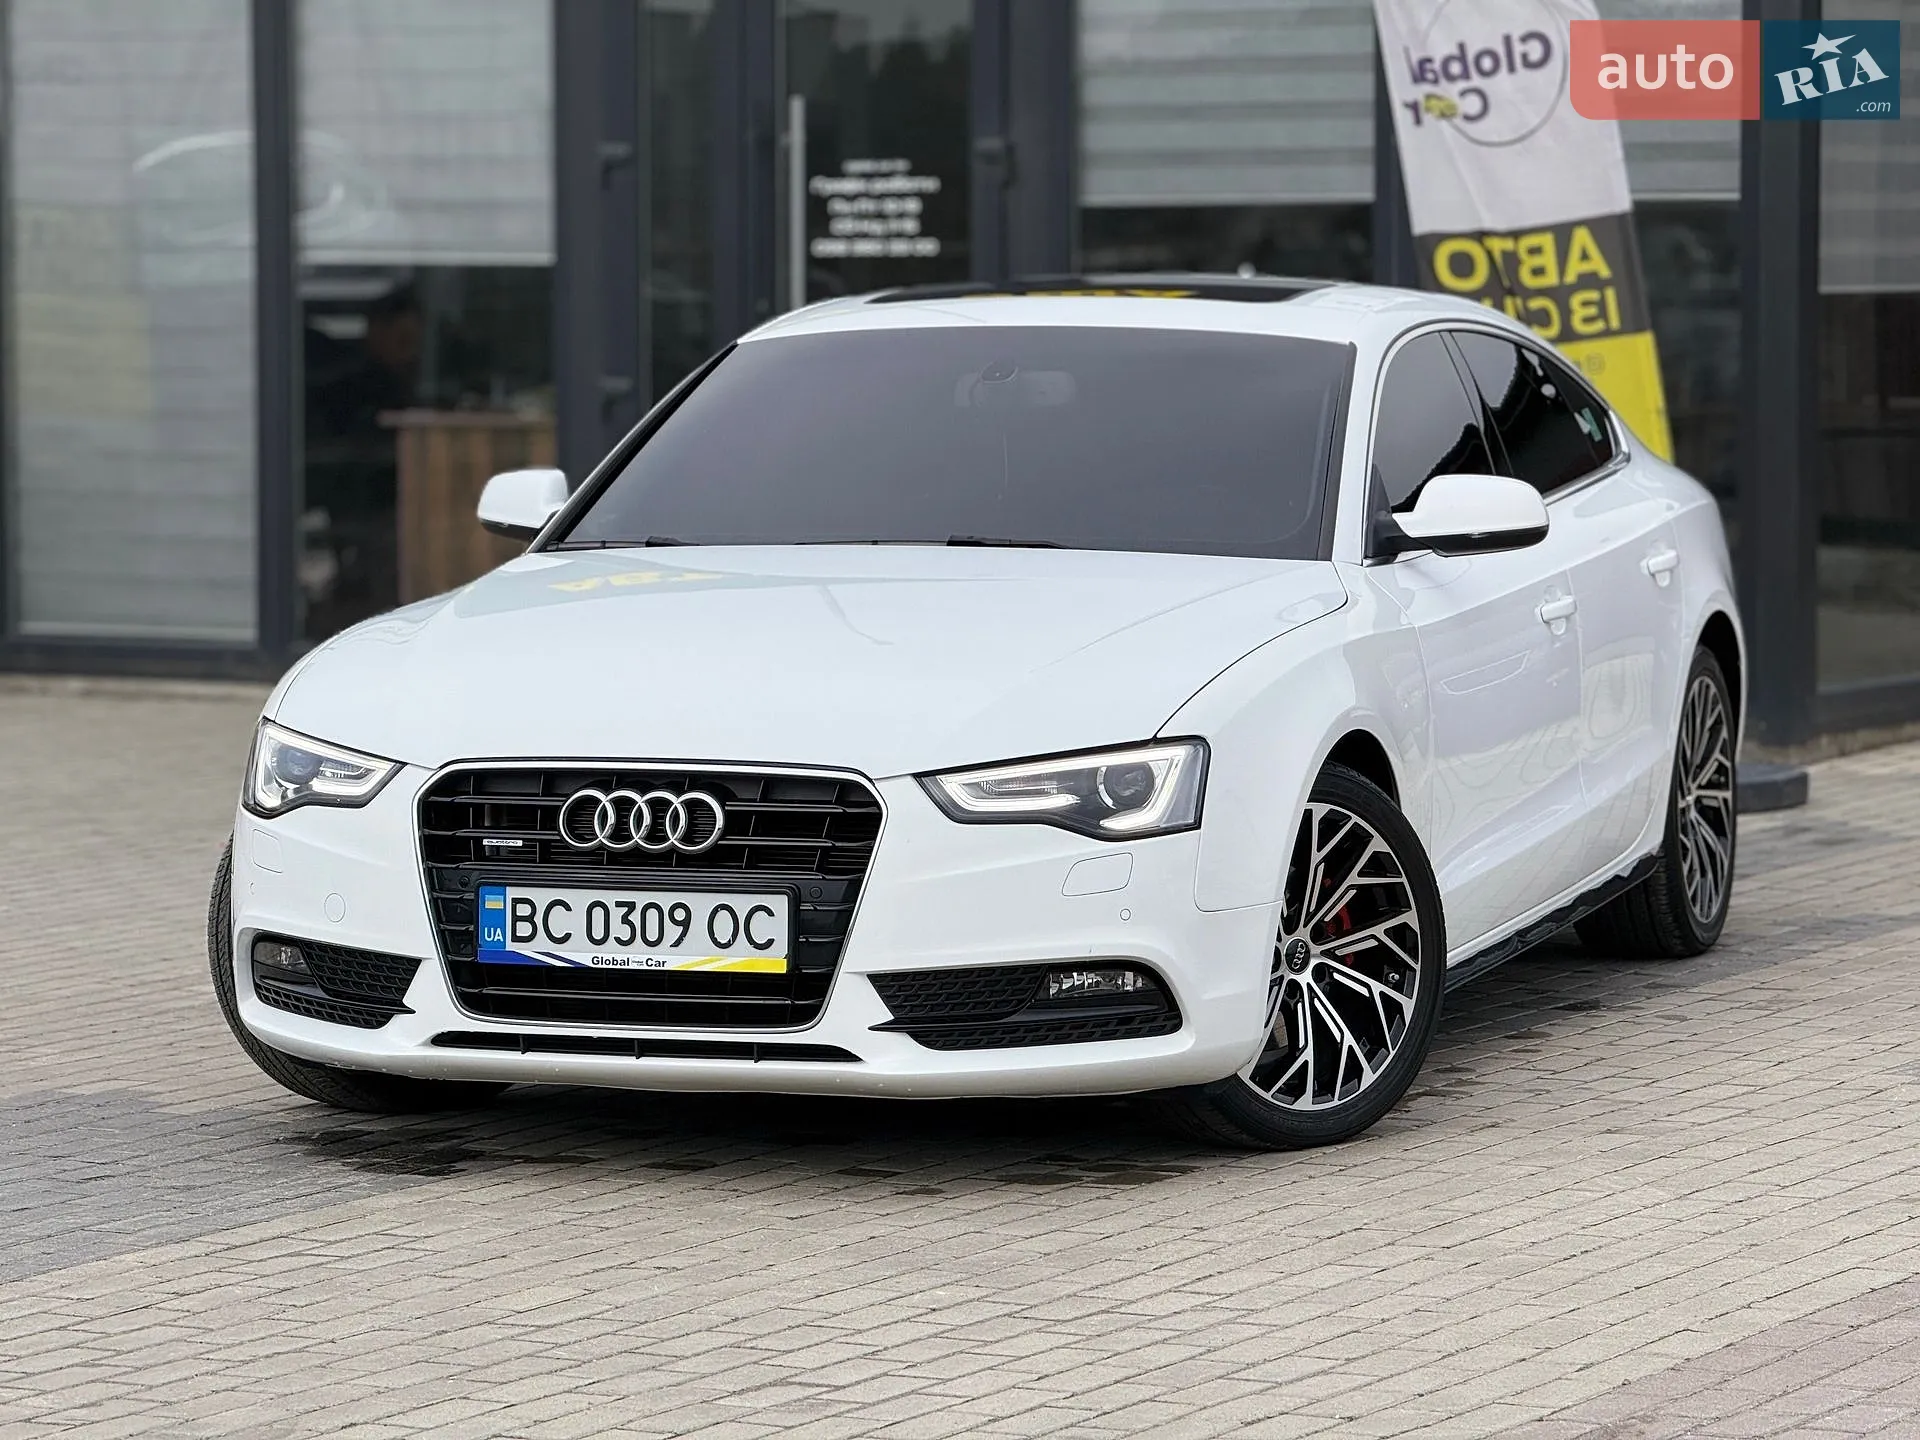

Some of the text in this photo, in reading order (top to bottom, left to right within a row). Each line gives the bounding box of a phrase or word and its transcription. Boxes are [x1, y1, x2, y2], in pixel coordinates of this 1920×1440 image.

[511, 897, 775, 949] BC 0309 OC
[485, 927, 504, 942] UA
[591, 956, 630, 966] Global
[645, 957, 667, 968] Car
